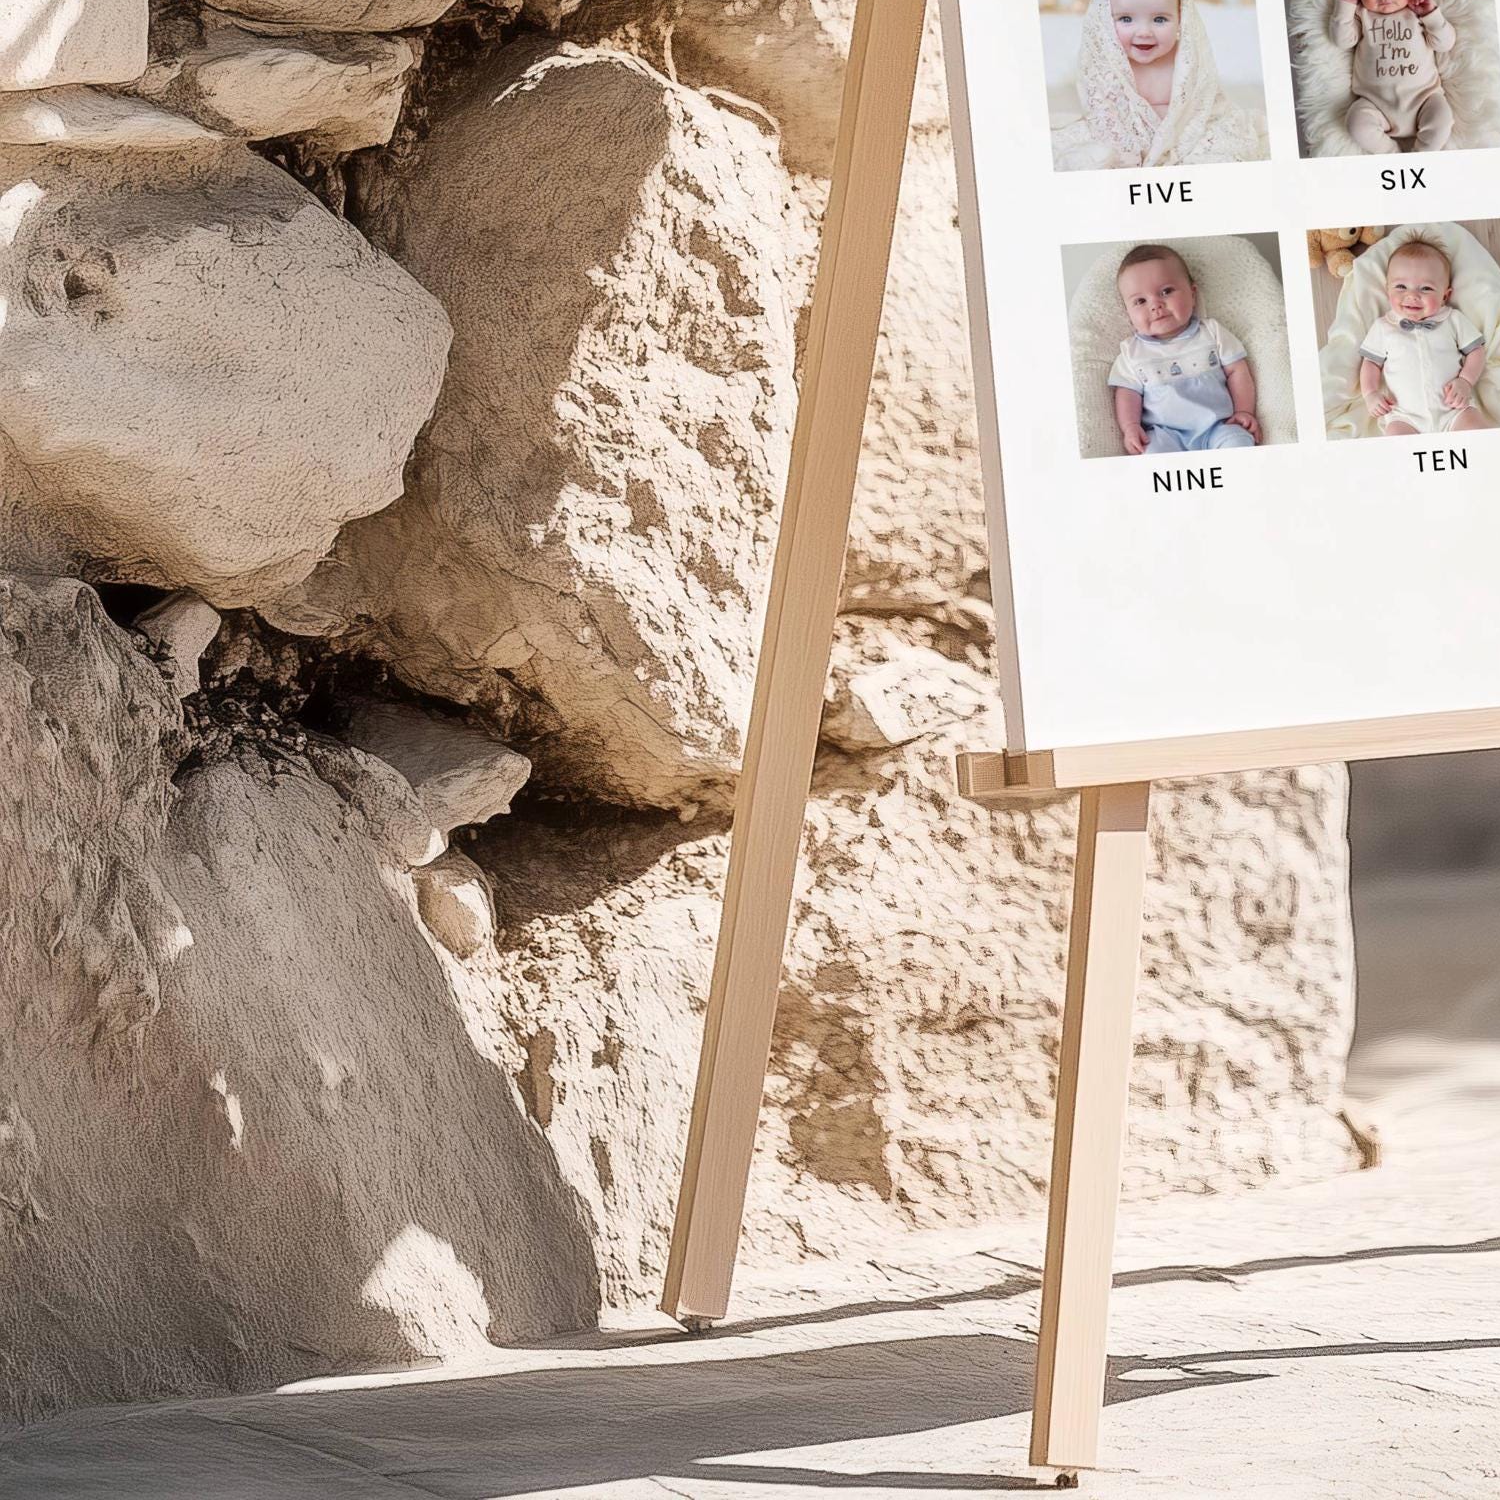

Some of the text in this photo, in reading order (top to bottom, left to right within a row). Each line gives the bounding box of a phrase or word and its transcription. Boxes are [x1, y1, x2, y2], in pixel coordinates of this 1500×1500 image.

[1369, 18, 1412, 43] Hello
[1379, 43, 1410, 60] I'm
[1375, 59, 1419, 78] here
[1380, 168, 1426, 191] SIX
[1129, 181, 1193, 205] FIVE
[1412, 448, 1468, 473] TEN
[1153, 466, 1224, 493] NINE
